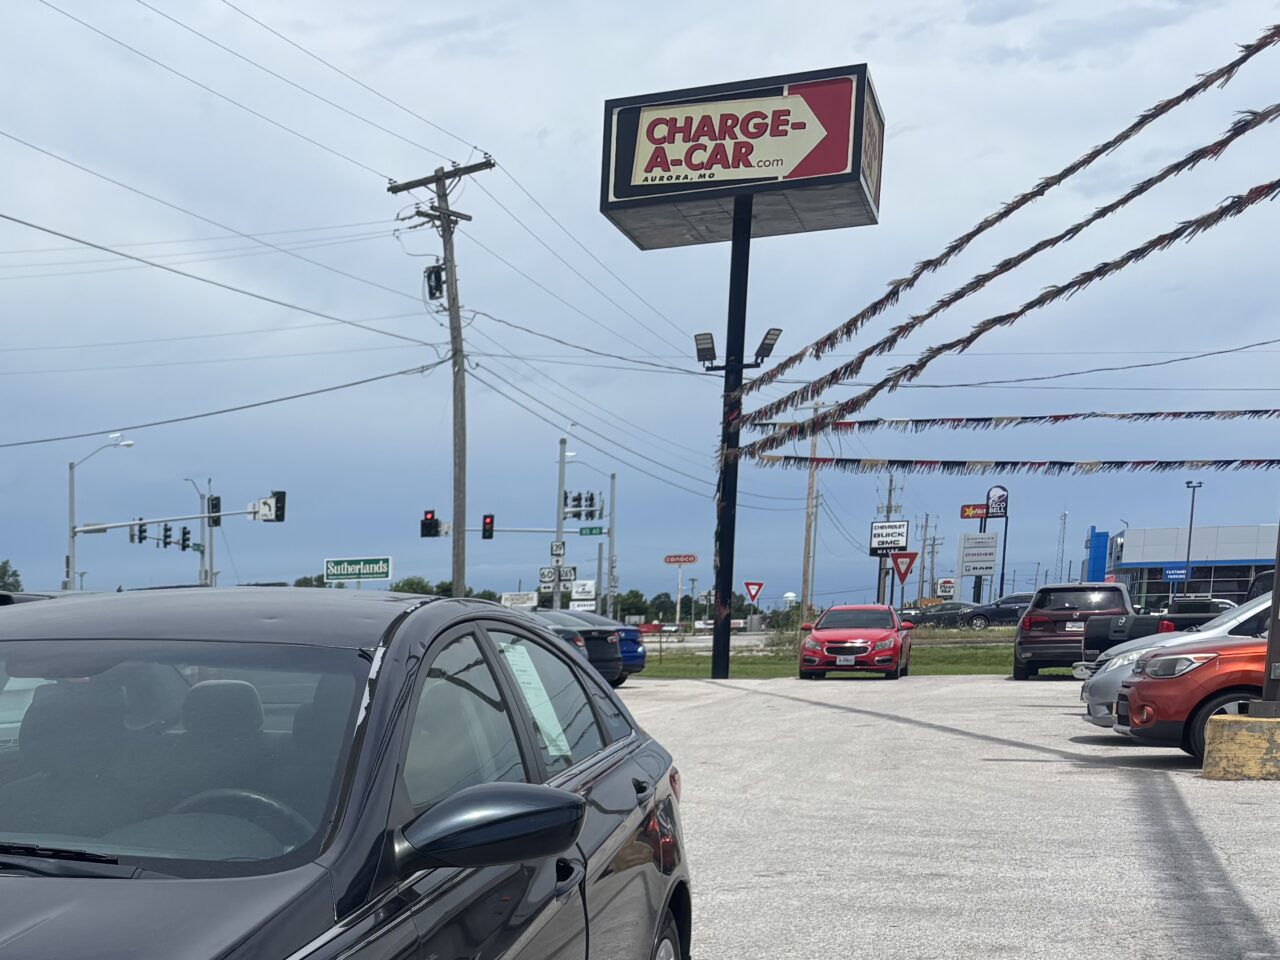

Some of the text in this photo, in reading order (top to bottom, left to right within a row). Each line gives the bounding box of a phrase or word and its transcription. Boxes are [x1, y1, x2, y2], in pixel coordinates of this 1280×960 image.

[646, 108, 807, 145] CHARGE-
[642, 172, 715, 183] AURORA, MO
[553, 544, 562, 552] 39
[327, 560, 388, 575] Sutherlands
[542, 571, 553, 579] 60
